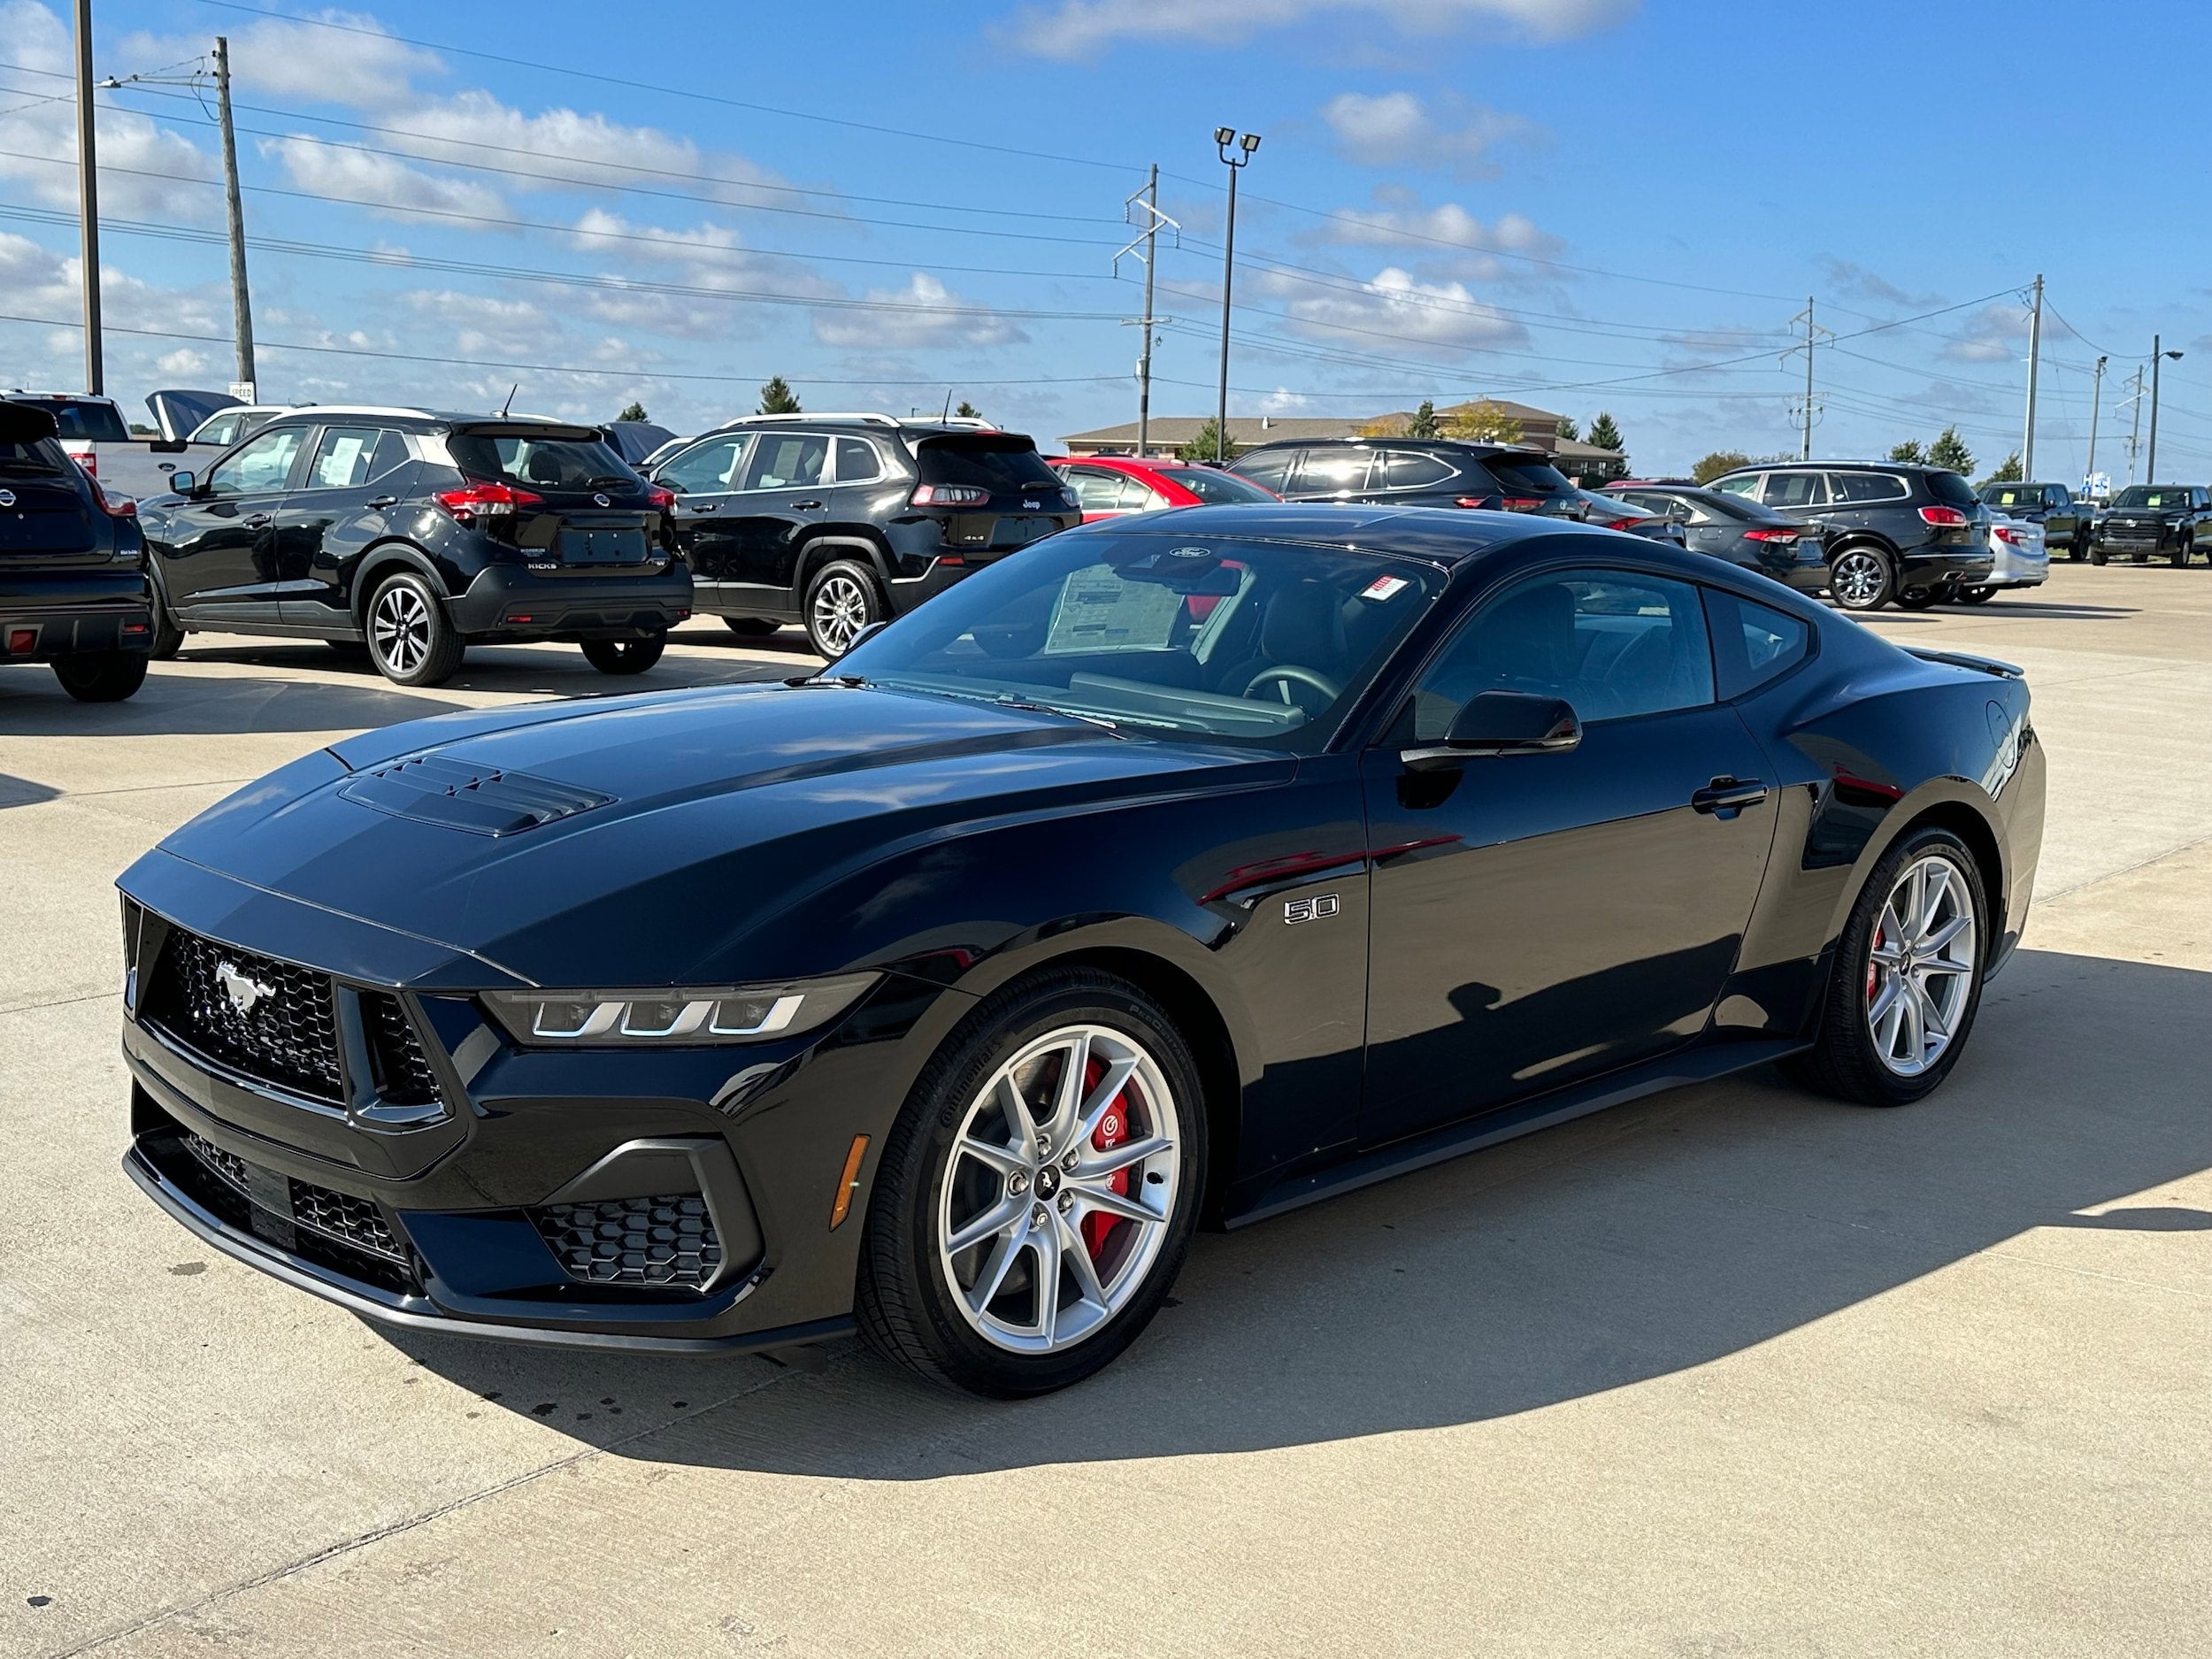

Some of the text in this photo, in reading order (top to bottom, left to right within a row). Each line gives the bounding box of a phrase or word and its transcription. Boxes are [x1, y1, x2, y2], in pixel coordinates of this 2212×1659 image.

[1023, 499, 1041, 510] Jeep
[1171, 547, 1207, 557] Ford
[940, 1042, 999, 1129] Continental
